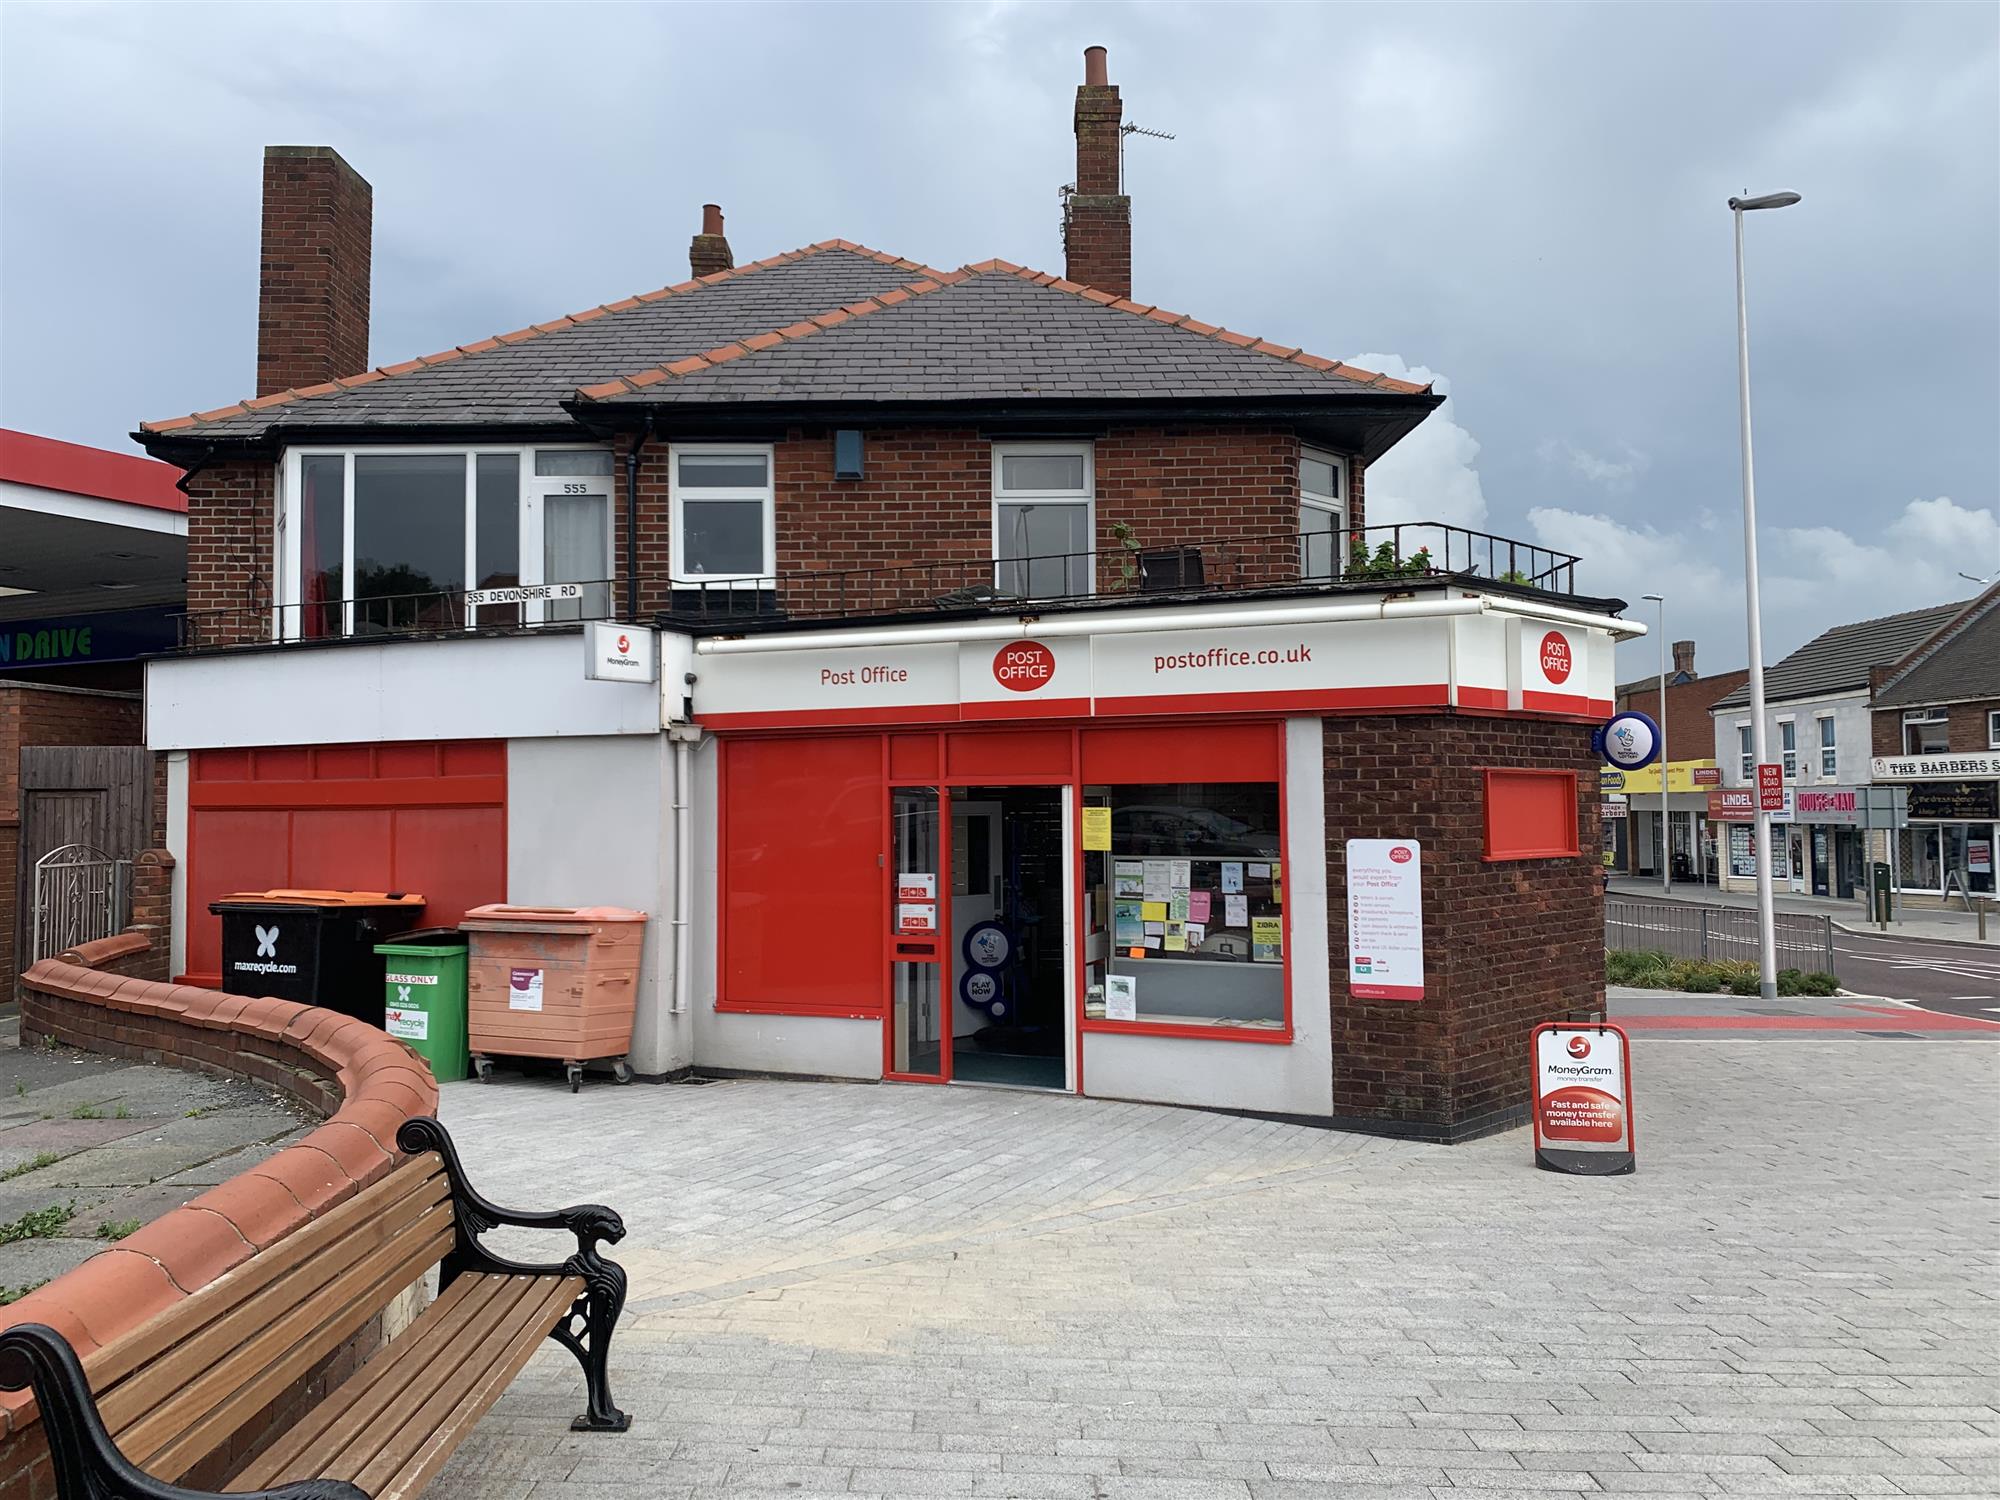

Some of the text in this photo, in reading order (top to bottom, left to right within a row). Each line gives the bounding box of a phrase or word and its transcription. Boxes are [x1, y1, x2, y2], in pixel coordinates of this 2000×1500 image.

[564, 484, 587, 494] 555
[468, 586, 576, 604] 555 DEVONSHIRE RD
[16, 626, 92, 660] DRIVE
[1547, 642, 1566, 656] POST
[607, 657, 640, 668] MoneyGram
[1006, 650, 1042, 665] POST
[1154, 644, 1312, 674] postoffice.co.uk
[1542, 656, 1568, 672] OFFICE
[820, 666, 908, 686] Post Office
[998, 665, 1048, 680] OFFICE
[1764, 768, 1778, 776] NEW
[1890, 763, 1916, 775] THE
[1920, 760, 1988, 774] BARBERS
[1764, 778, 1778, 786] ROAD
[1761, 788, 1782, 796] LAYOUT
[1762, 798, 1782, 807] AHEAD
[234, 961, 296, 974] maxrecycle.com
[386, 974, 408, 982] GLASS
[1552, 1100, 1570, 1108] Fast
[1572, 1101, 1589, 1109] and
[1578, 1111, 1616, 1119] transfer
[1550, 1118, 1612, 1128] available here
